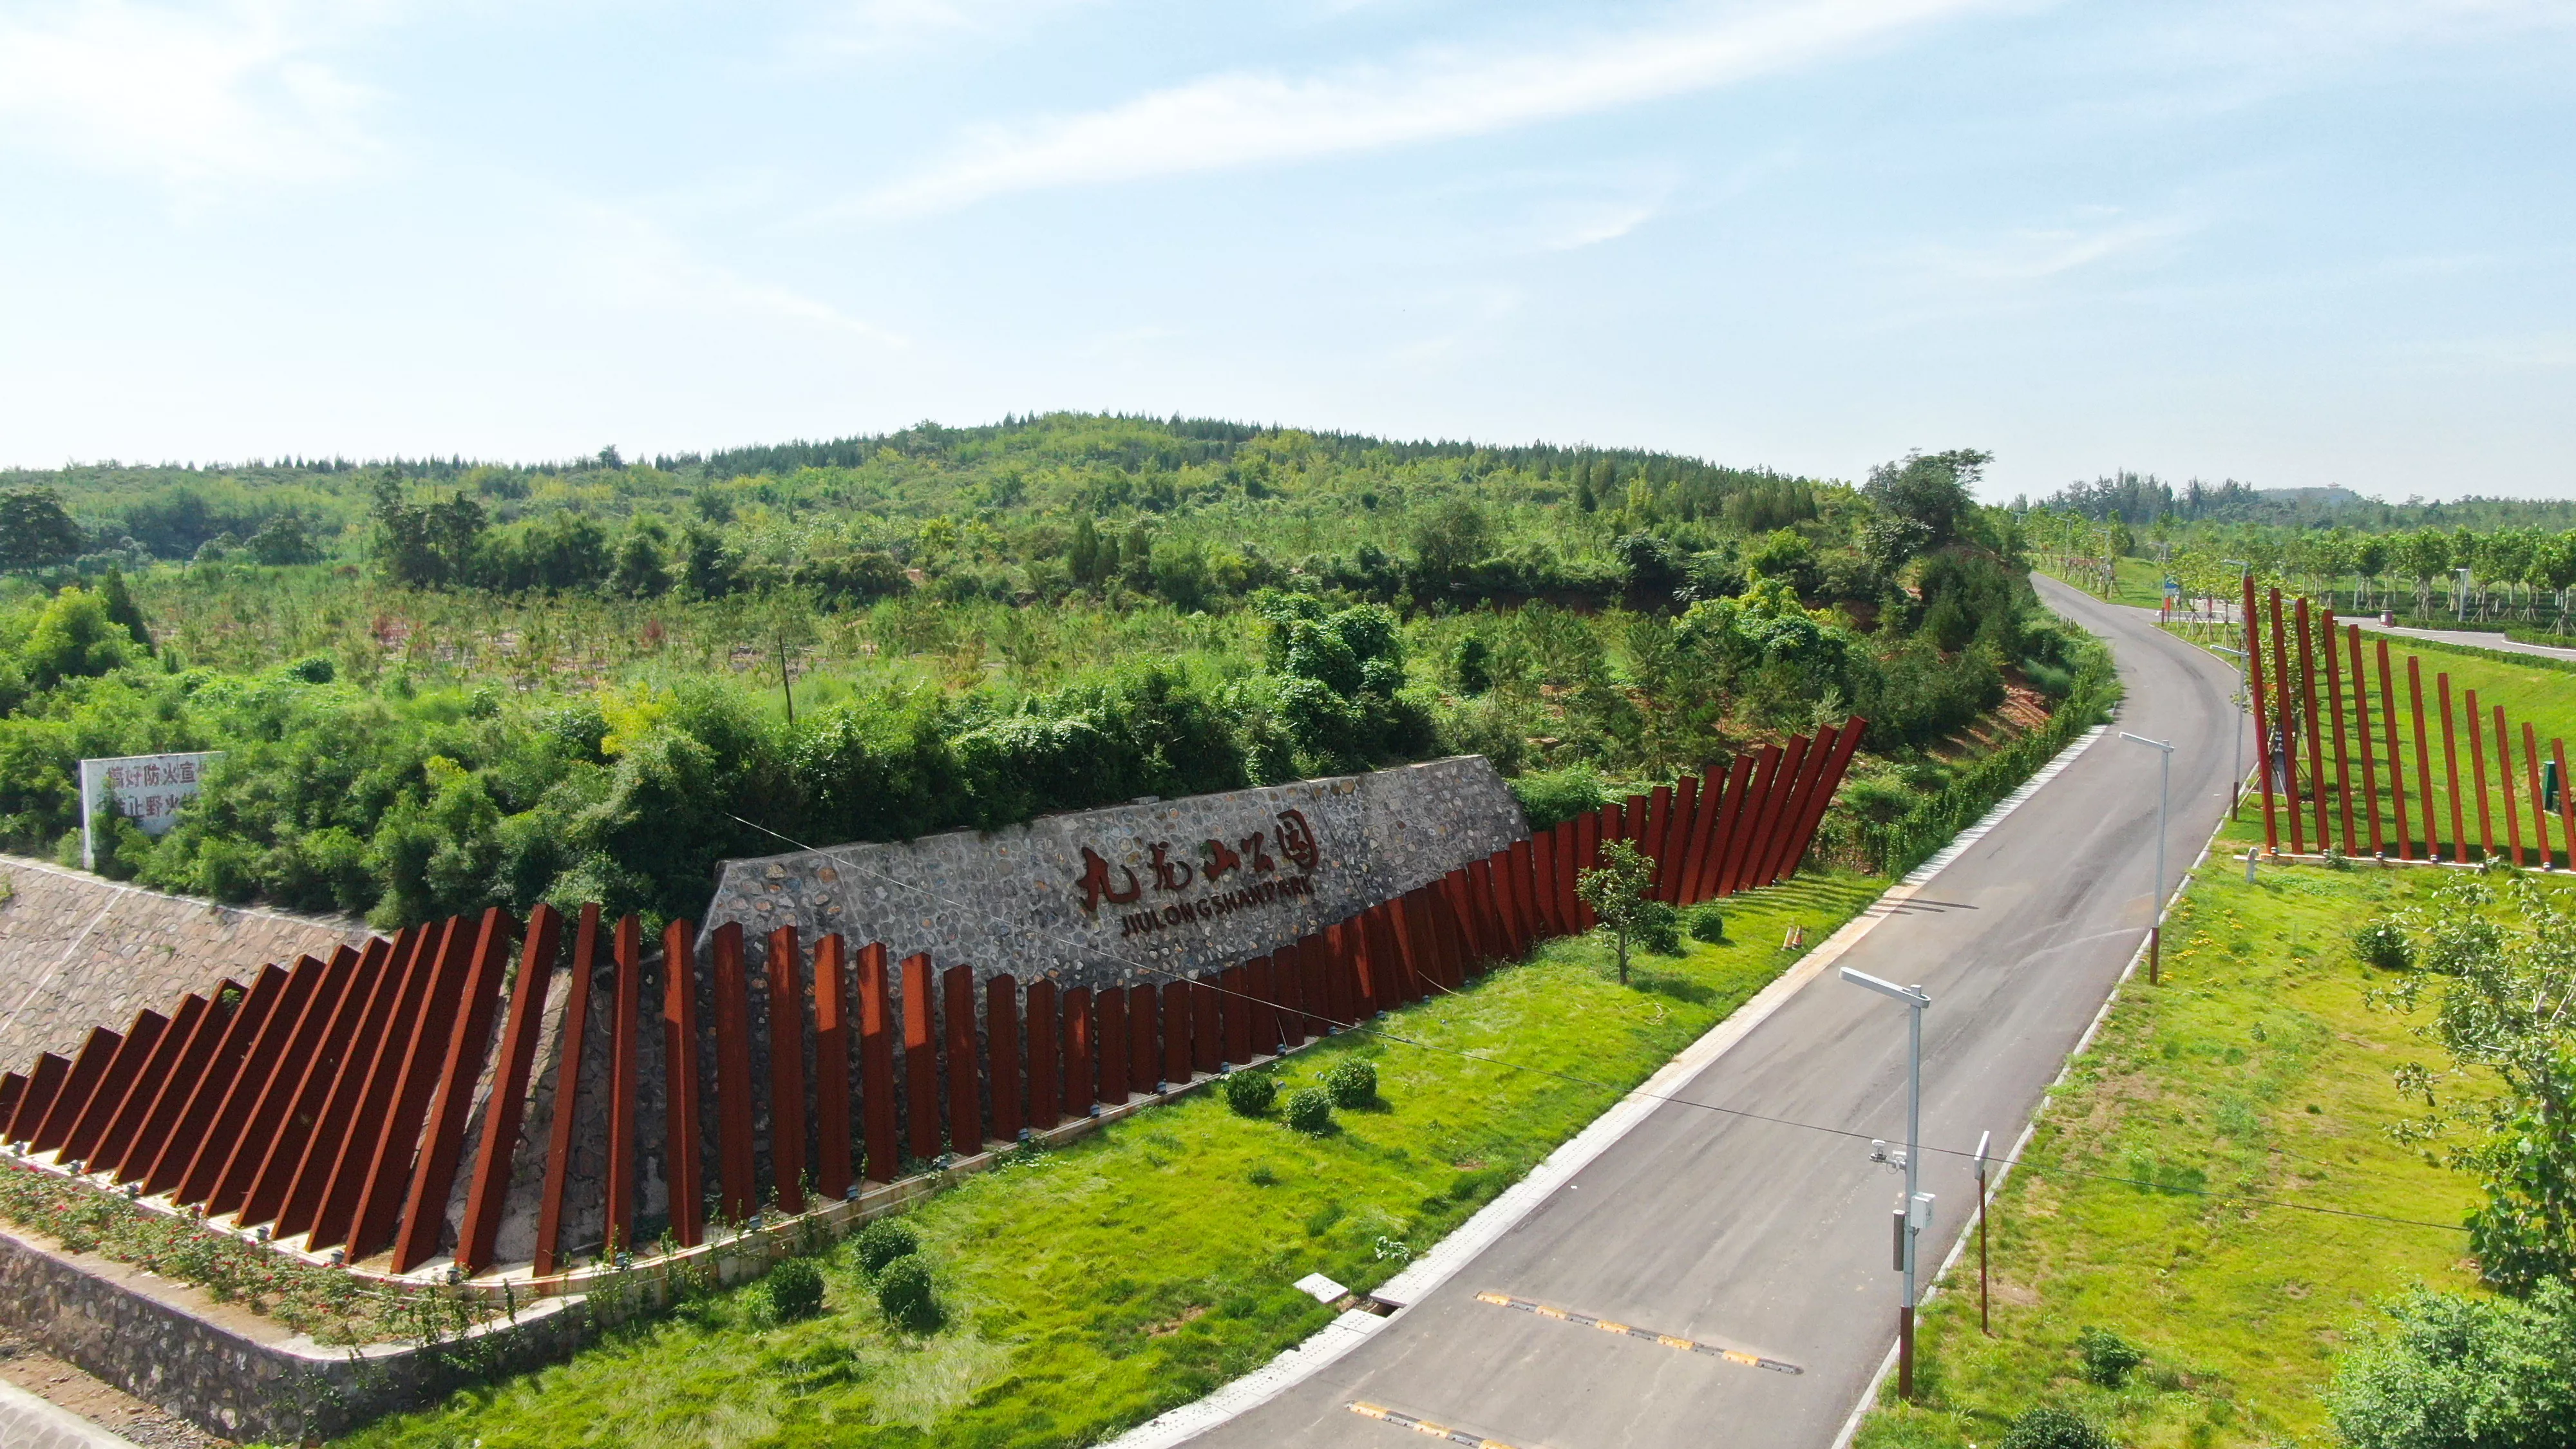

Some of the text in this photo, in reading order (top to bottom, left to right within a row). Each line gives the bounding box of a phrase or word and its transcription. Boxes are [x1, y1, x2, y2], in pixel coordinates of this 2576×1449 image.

[115, 791, 198, 818] 止野火
[1077, 809, 1319, 912] 九龙山公园
